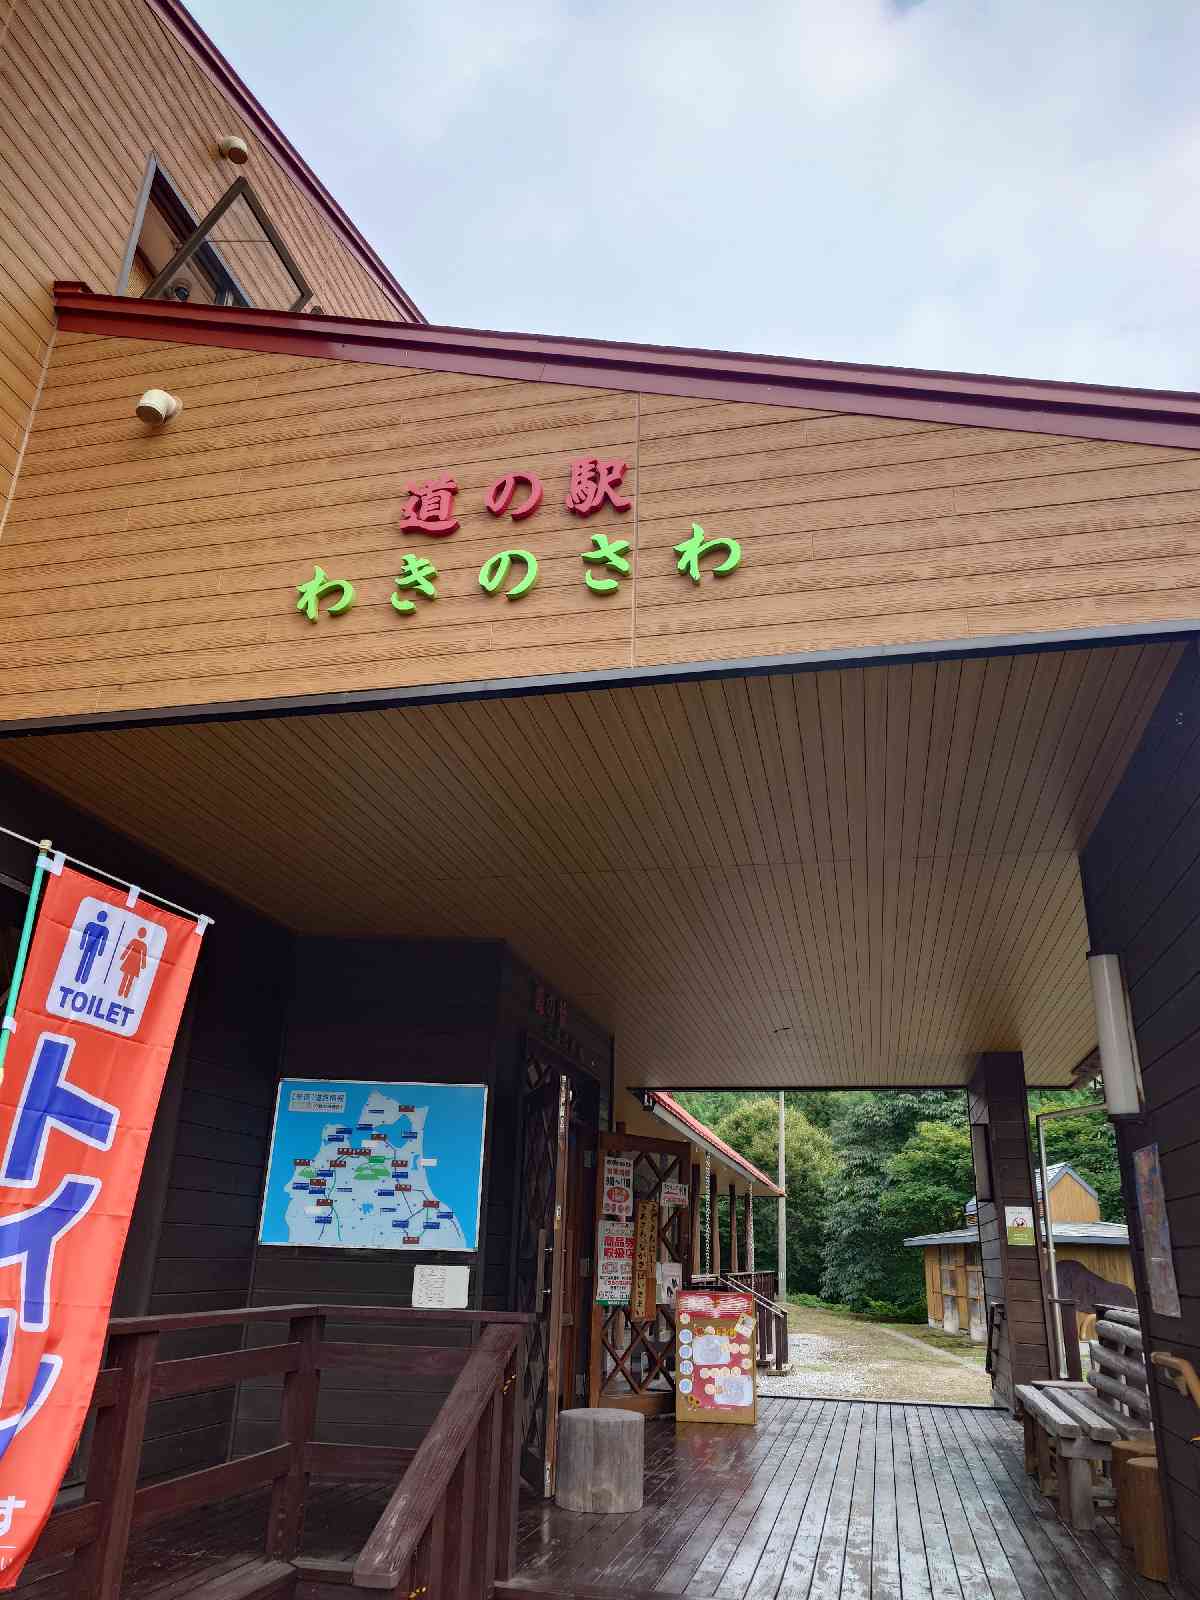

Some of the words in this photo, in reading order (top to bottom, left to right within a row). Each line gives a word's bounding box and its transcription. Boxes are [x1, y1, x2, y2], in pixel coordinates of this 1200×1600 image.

[400, 455, 631, 537] 道の駅
[296, 521, 742, 623] わきのさわ
[58, 985, 135, 1028] TOILET
